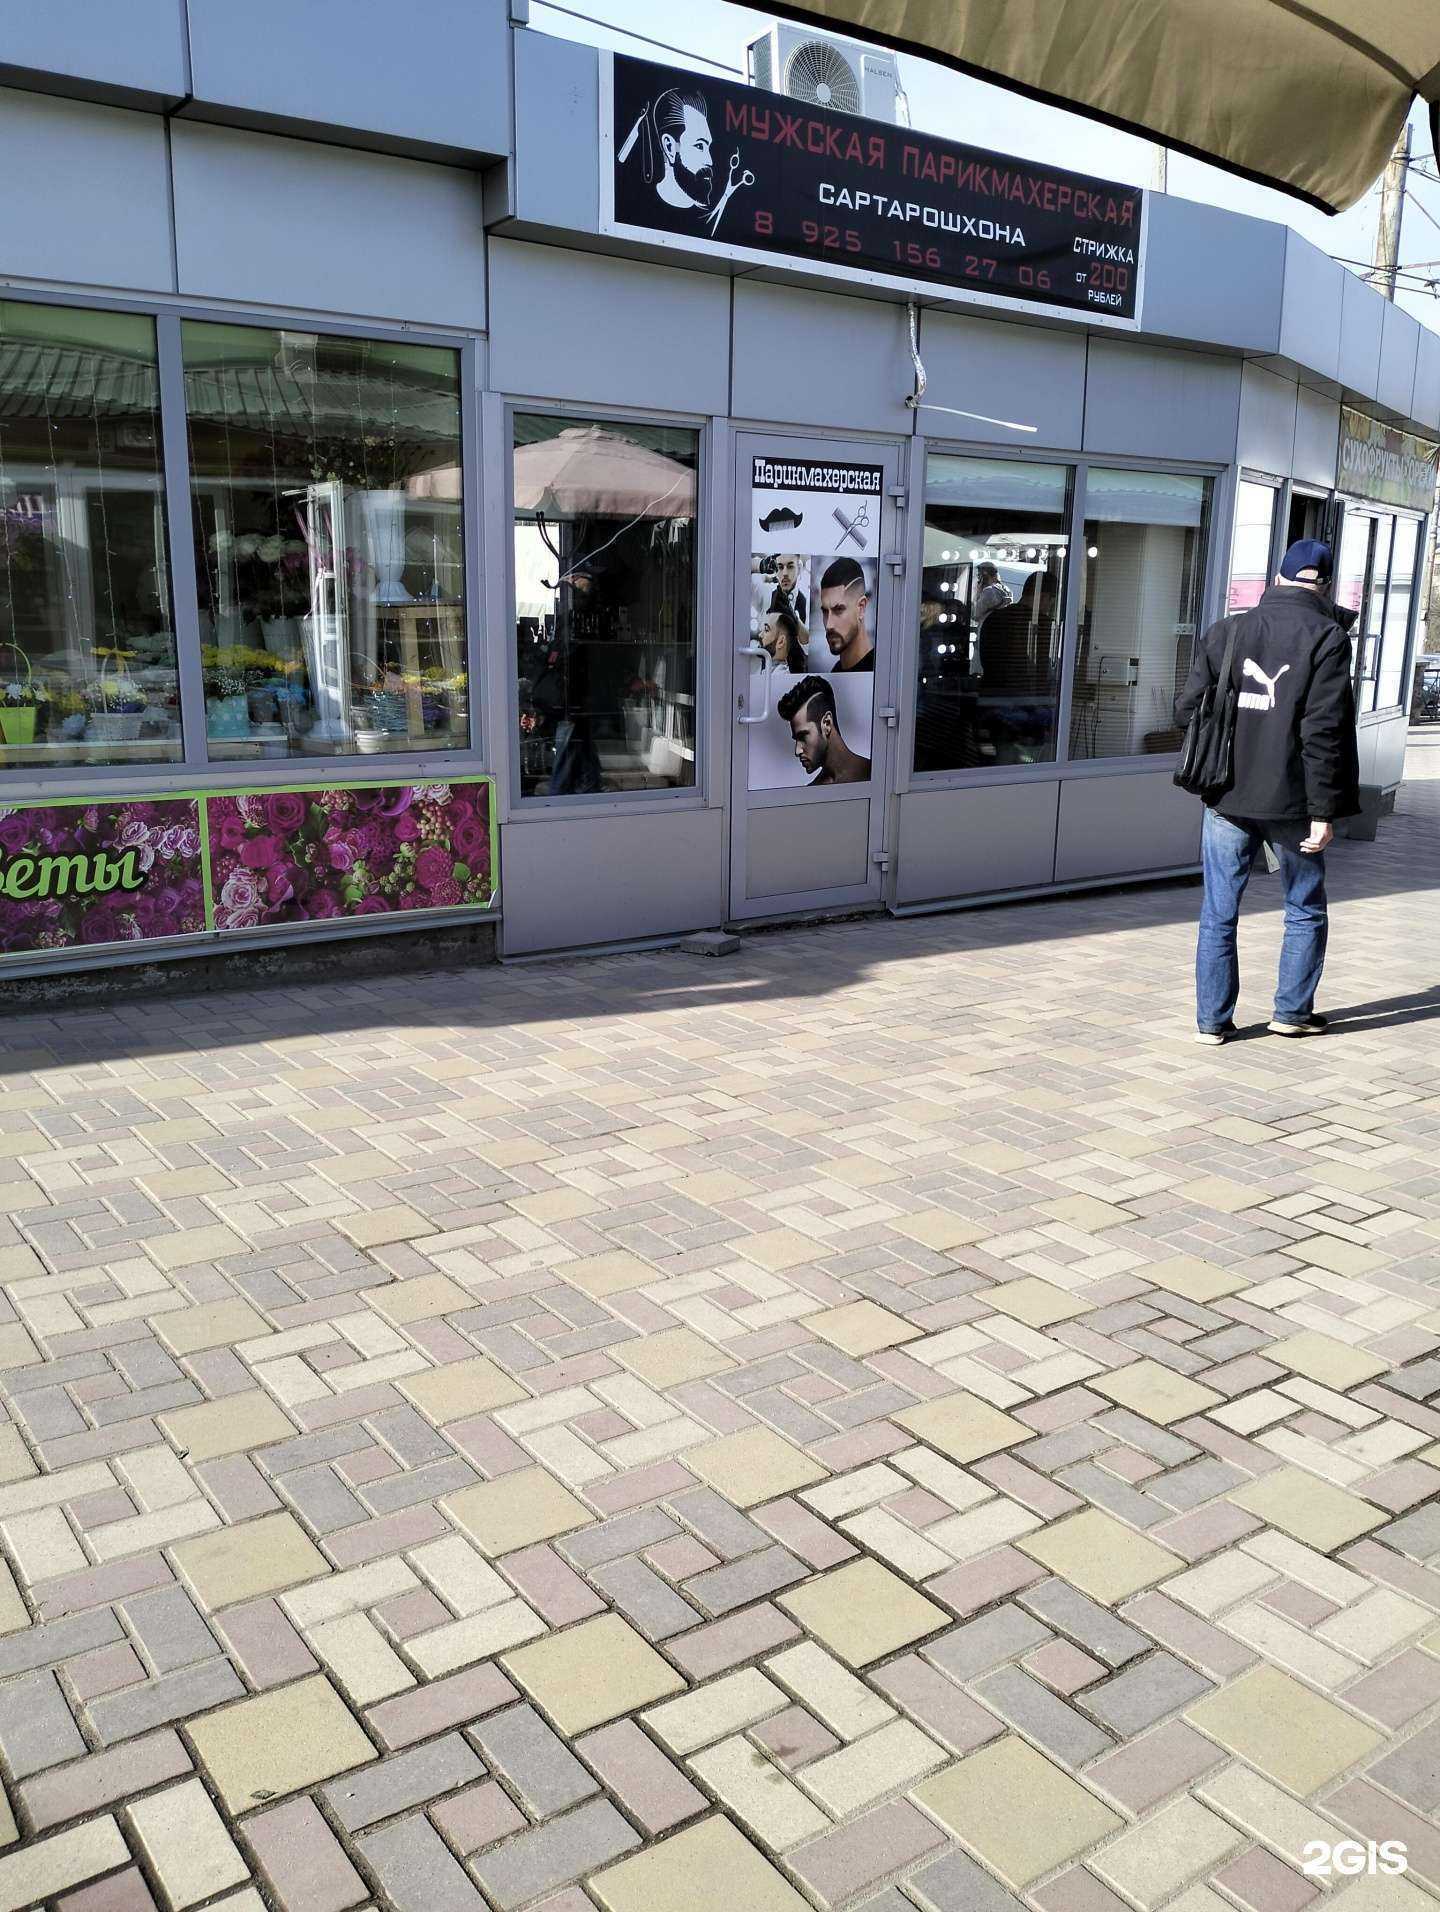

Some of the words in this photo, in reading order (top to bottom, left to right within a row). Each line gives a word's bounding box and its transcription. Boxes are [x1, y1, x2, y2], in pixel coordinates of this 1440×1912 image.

[725, 101, 885, 169] МУЖСКАЯ
[902, 146, 1134, 228] ПАРИКМАХЕРСКАЯ
[819, 183, 1026, 247] САРТАРОШХОНА
[754, 210, 773, 235] 8
[802, 220, 862, 252] 925
[893, 240, 941, 268] 156
[965, 255, 997, 280] 27
[1018, 266, 1051, 289] 06
[1073, 236, 1134, 264] СТРИЖКА
[1088, 261, 1128, 290] 200
[1088, 289, 1122, 306] РУБЛЕЙ
[754, 459, 881, 492] Парикмахерская
[0, 848, 143, 898] еты
